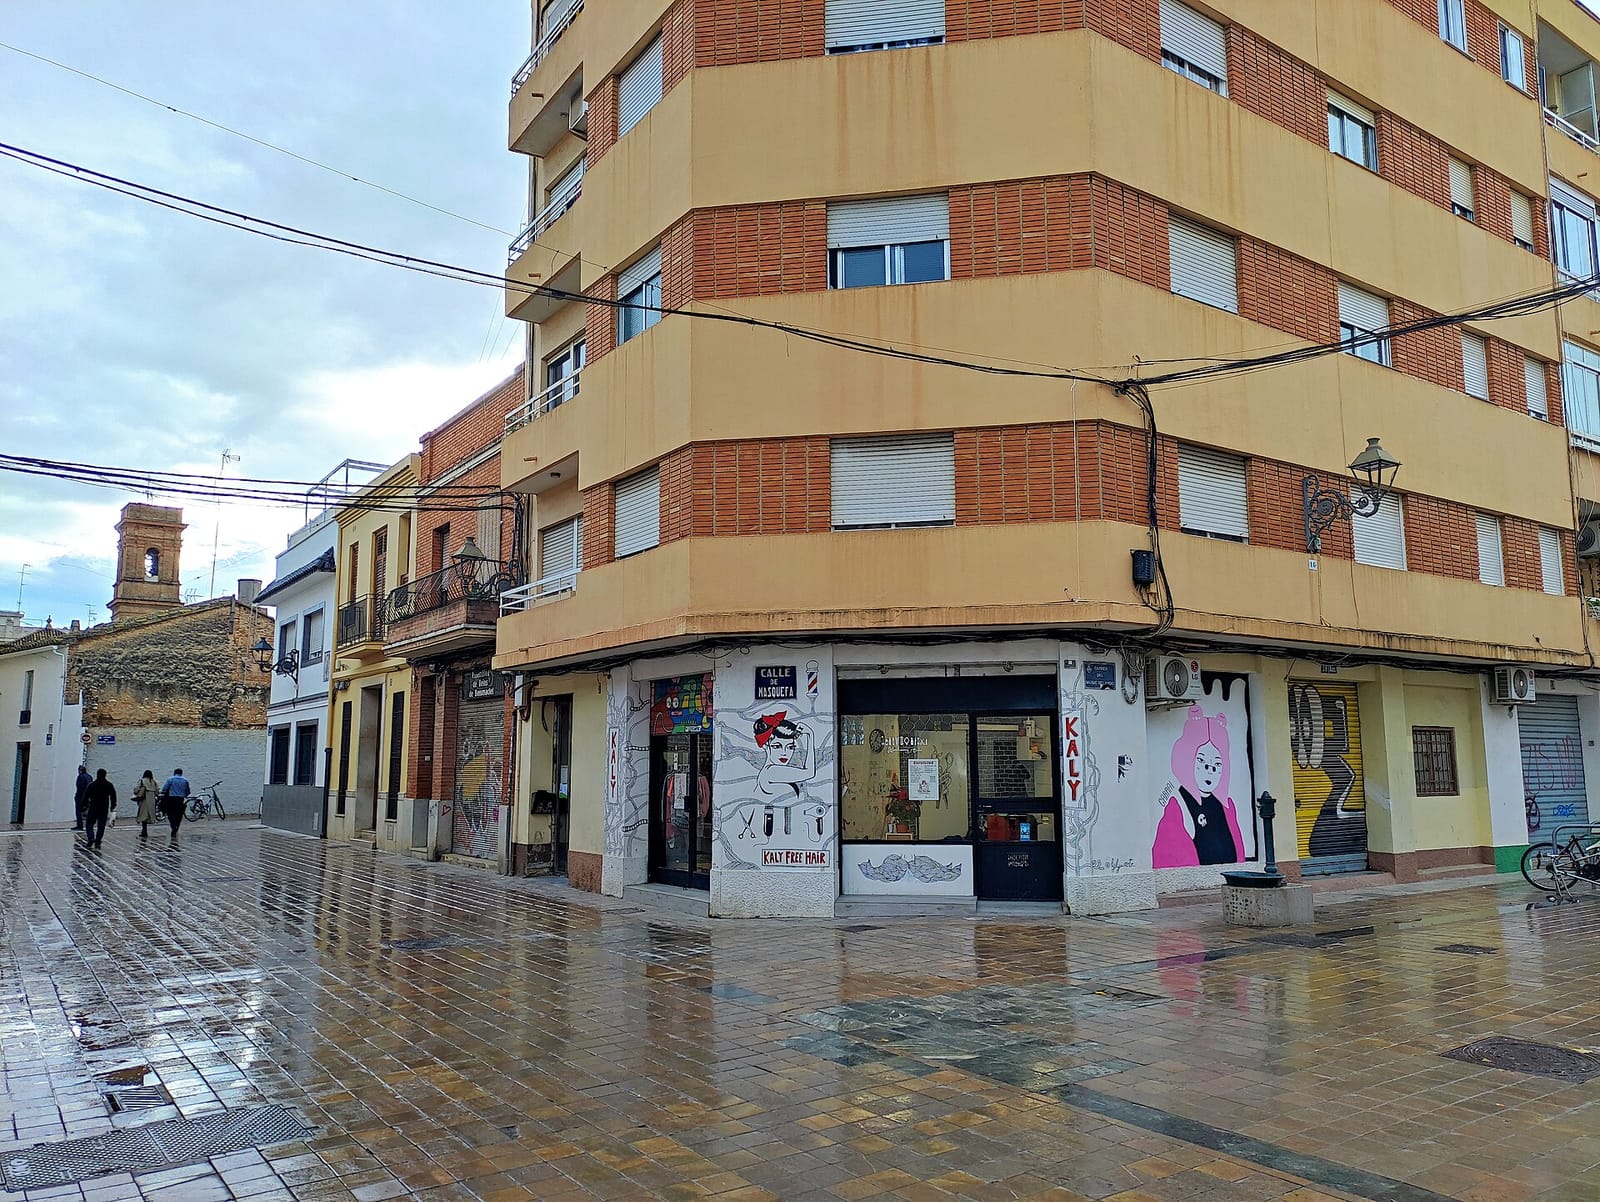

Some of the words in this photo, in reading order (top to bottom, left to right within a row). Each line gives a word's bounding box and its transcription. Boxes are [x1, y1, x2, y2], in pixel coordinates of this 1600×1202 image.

[760, 668, 791, 678] CALLE
[610, 731, 618, 799] KALY
[1065, 717, 1081, 801] KALY
[763, 851, 783, 864] KALY
[785, 851, 803, 864] FREE
